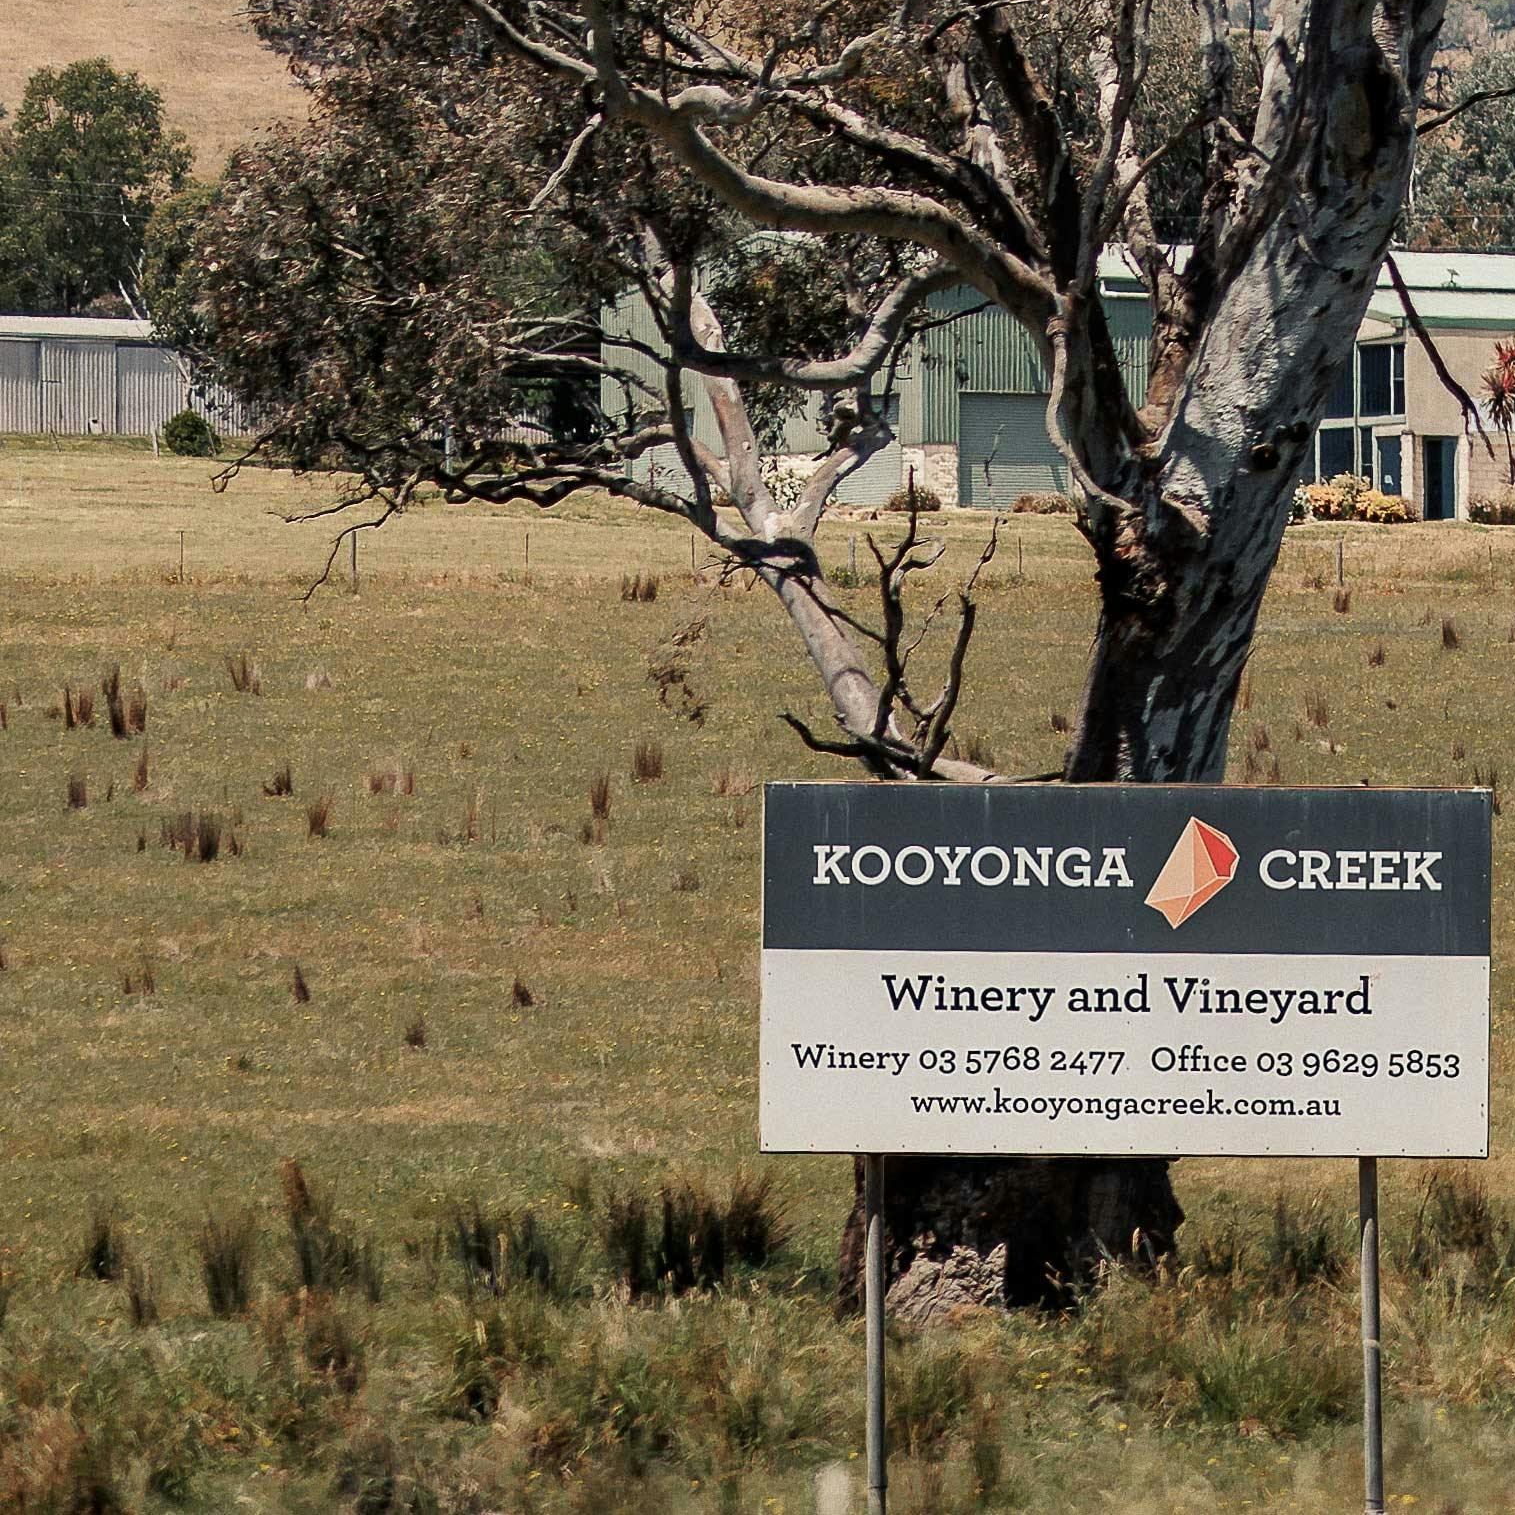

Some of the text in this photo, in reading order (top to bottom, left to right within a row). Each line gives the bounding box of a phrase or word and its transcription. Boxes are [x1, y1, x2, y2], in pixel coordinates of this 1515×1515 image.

[813, 845, 1443, 892] KOOYONGA CREEK
[881, 973, 1373, 1024] Winery and Vineyard
[790, 1043, 1461, 1079] Winery 03 5768 2477 Office 03 9629 5853
[911, 1087, 1342, 1121] www.kooyongacreek.com.au
